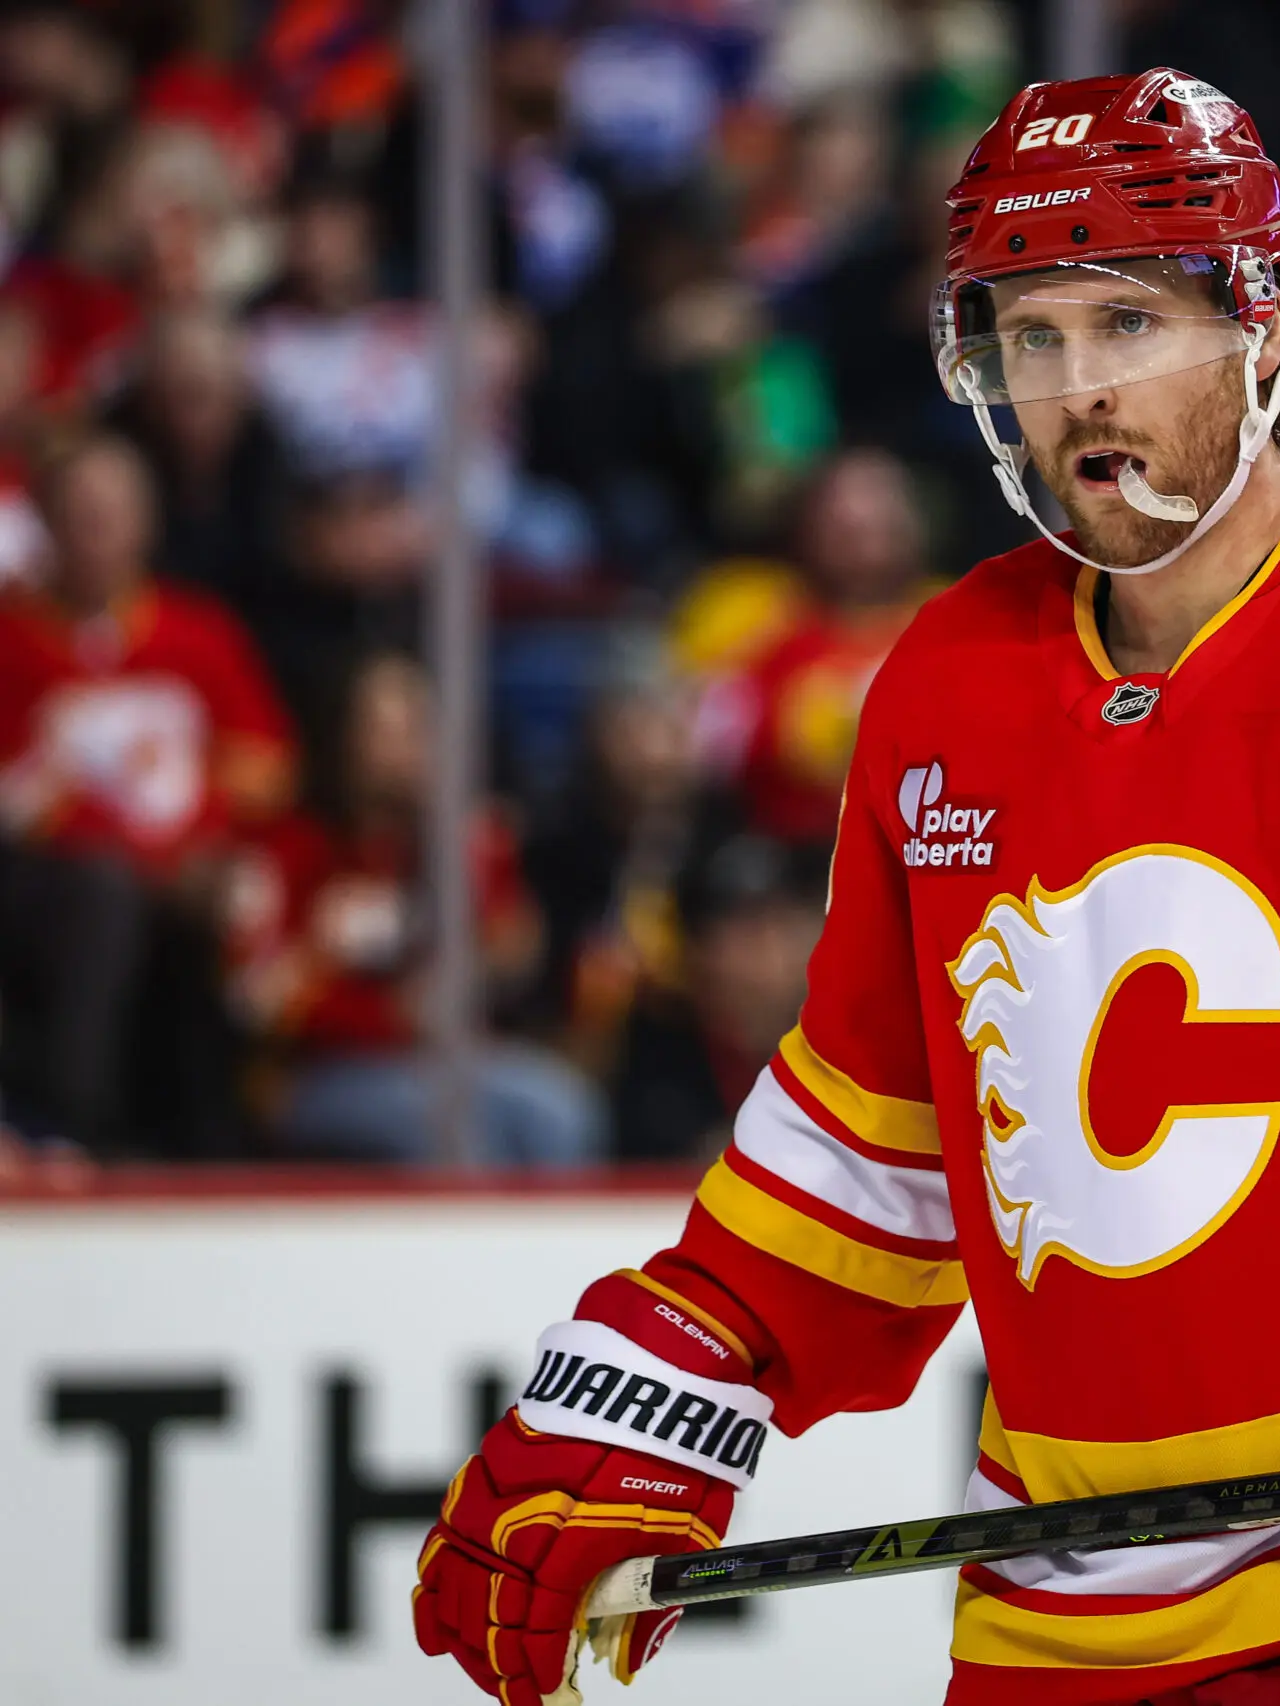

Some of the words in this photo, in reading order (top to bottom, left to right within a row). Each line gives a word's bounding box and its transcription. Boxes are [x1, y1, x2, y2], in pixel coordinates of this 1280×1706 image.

[1016, 113, 1094, 152] 20
[994, 187, 1091, 214] BAUER
[1111, 697, 1147, 715] NHL
[922, 803, 997, 839] play
[654, 1303, 730, 1361] COLEMAN
[620, 1476, 688, 1496] COVERT
[1219, 1480, 1280, 1498] ALPHA
